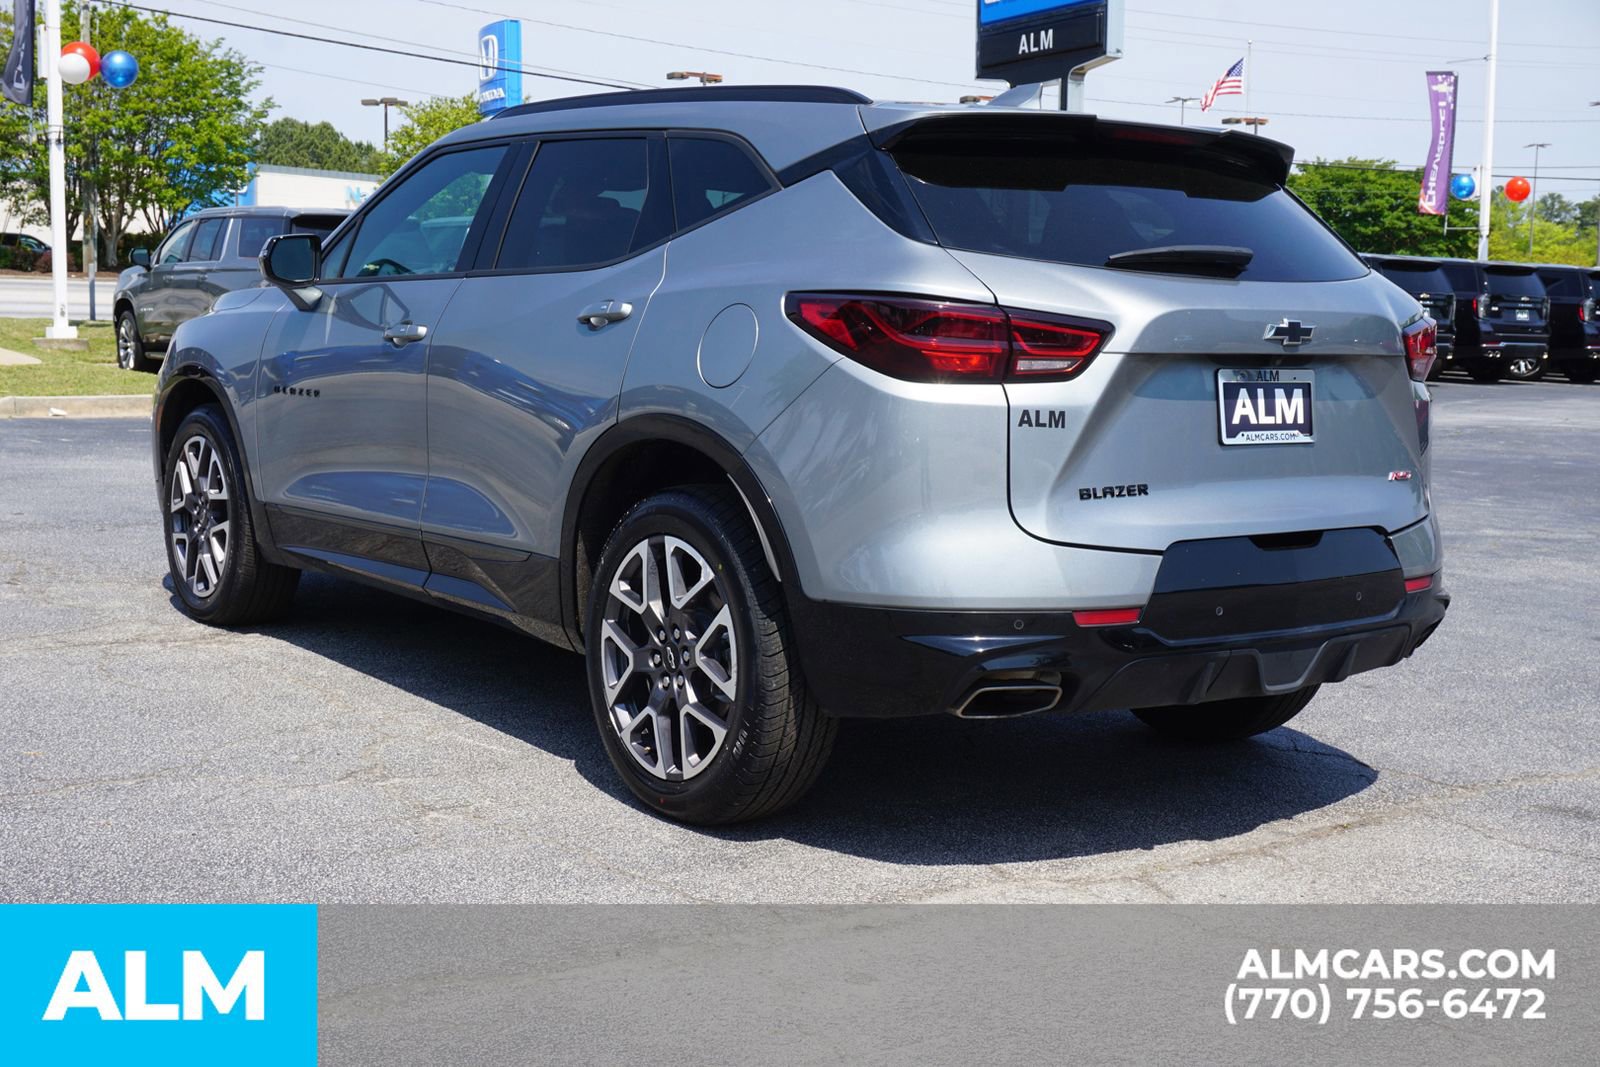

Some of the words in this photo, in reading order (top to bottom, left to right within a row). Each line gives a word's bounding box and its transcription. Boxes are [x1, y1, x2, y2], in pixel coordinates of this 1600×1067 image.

[1018, 28, 1054, 55] ALM
[1256, 370, 1280, 382] ALM
[1231, 387, 1304, 425] ALM
[1018, 409, 1066, 429] ALM
[1245, 432, 1297, 442] ALMCARS.COM
[1078, 483, 1149, 501] BLAZER
